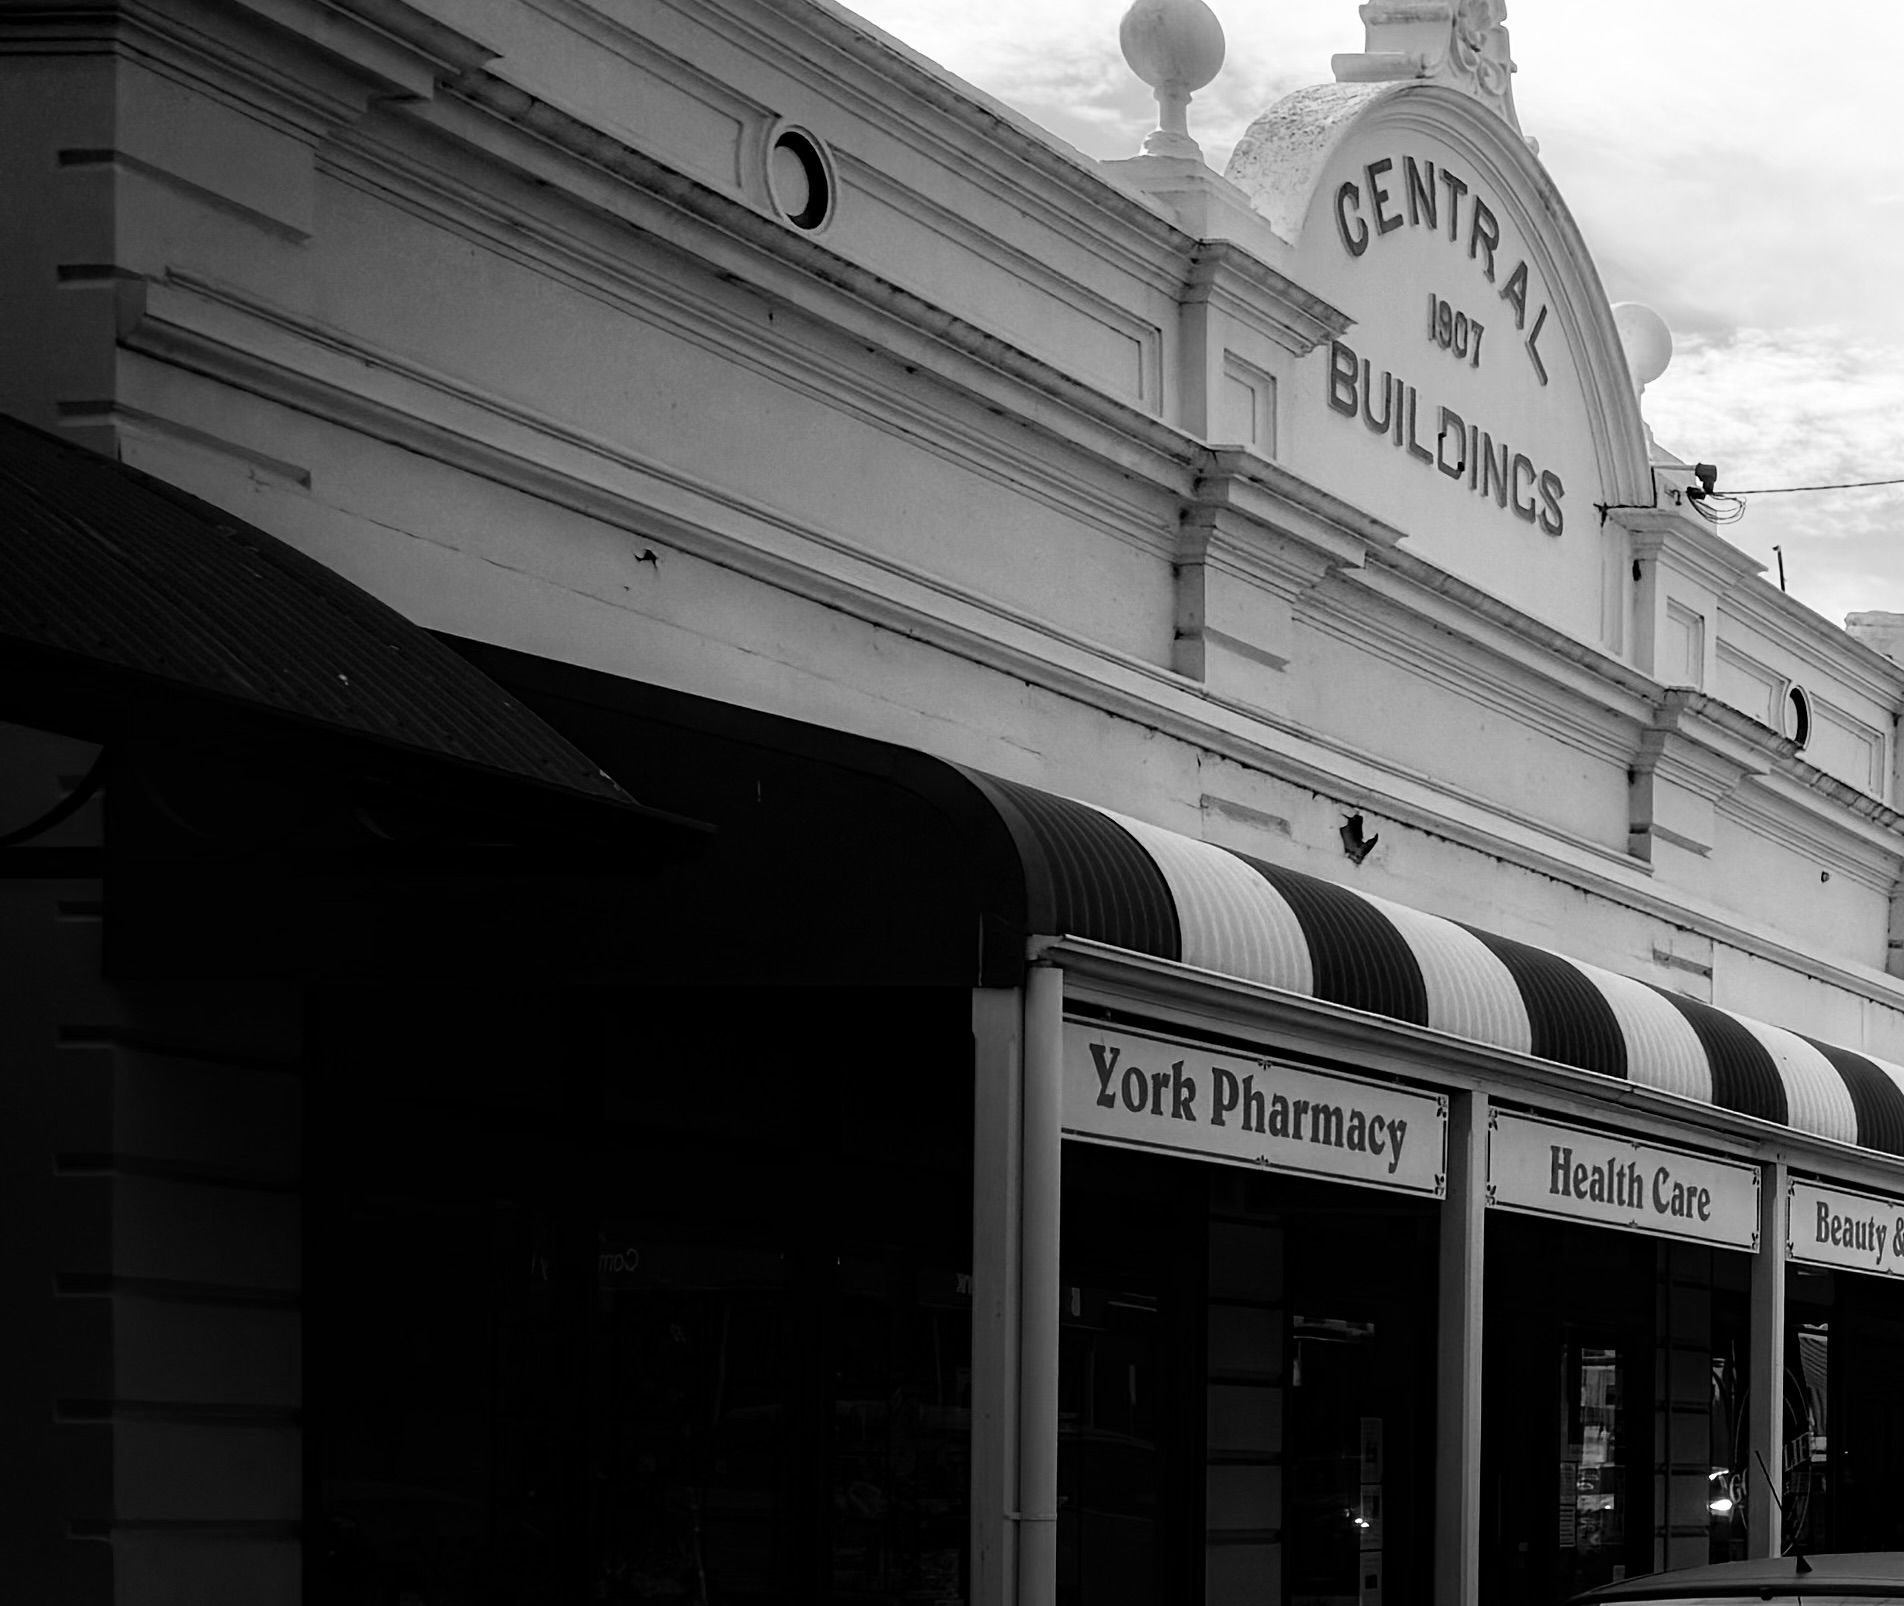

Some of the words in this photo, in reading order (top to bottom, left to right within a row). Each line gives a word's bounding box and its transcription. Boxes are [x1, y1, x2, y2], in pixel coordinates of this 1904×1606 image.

[1335, 156, 1549, 386] CENTRAL
[1428, 293, 1484, 368] 1907
[1328, 341, 1565, 537] BUILDINGS
[1089, 1043, 1196, 1121] York
[1211, 1067, 1407, 1173] Pharmacy
[1549, 1145, 1643, 1210] Health
[1652, 1167, 1711, 1221] Care
[1816, 1201, 1887, 1265] Beauty
